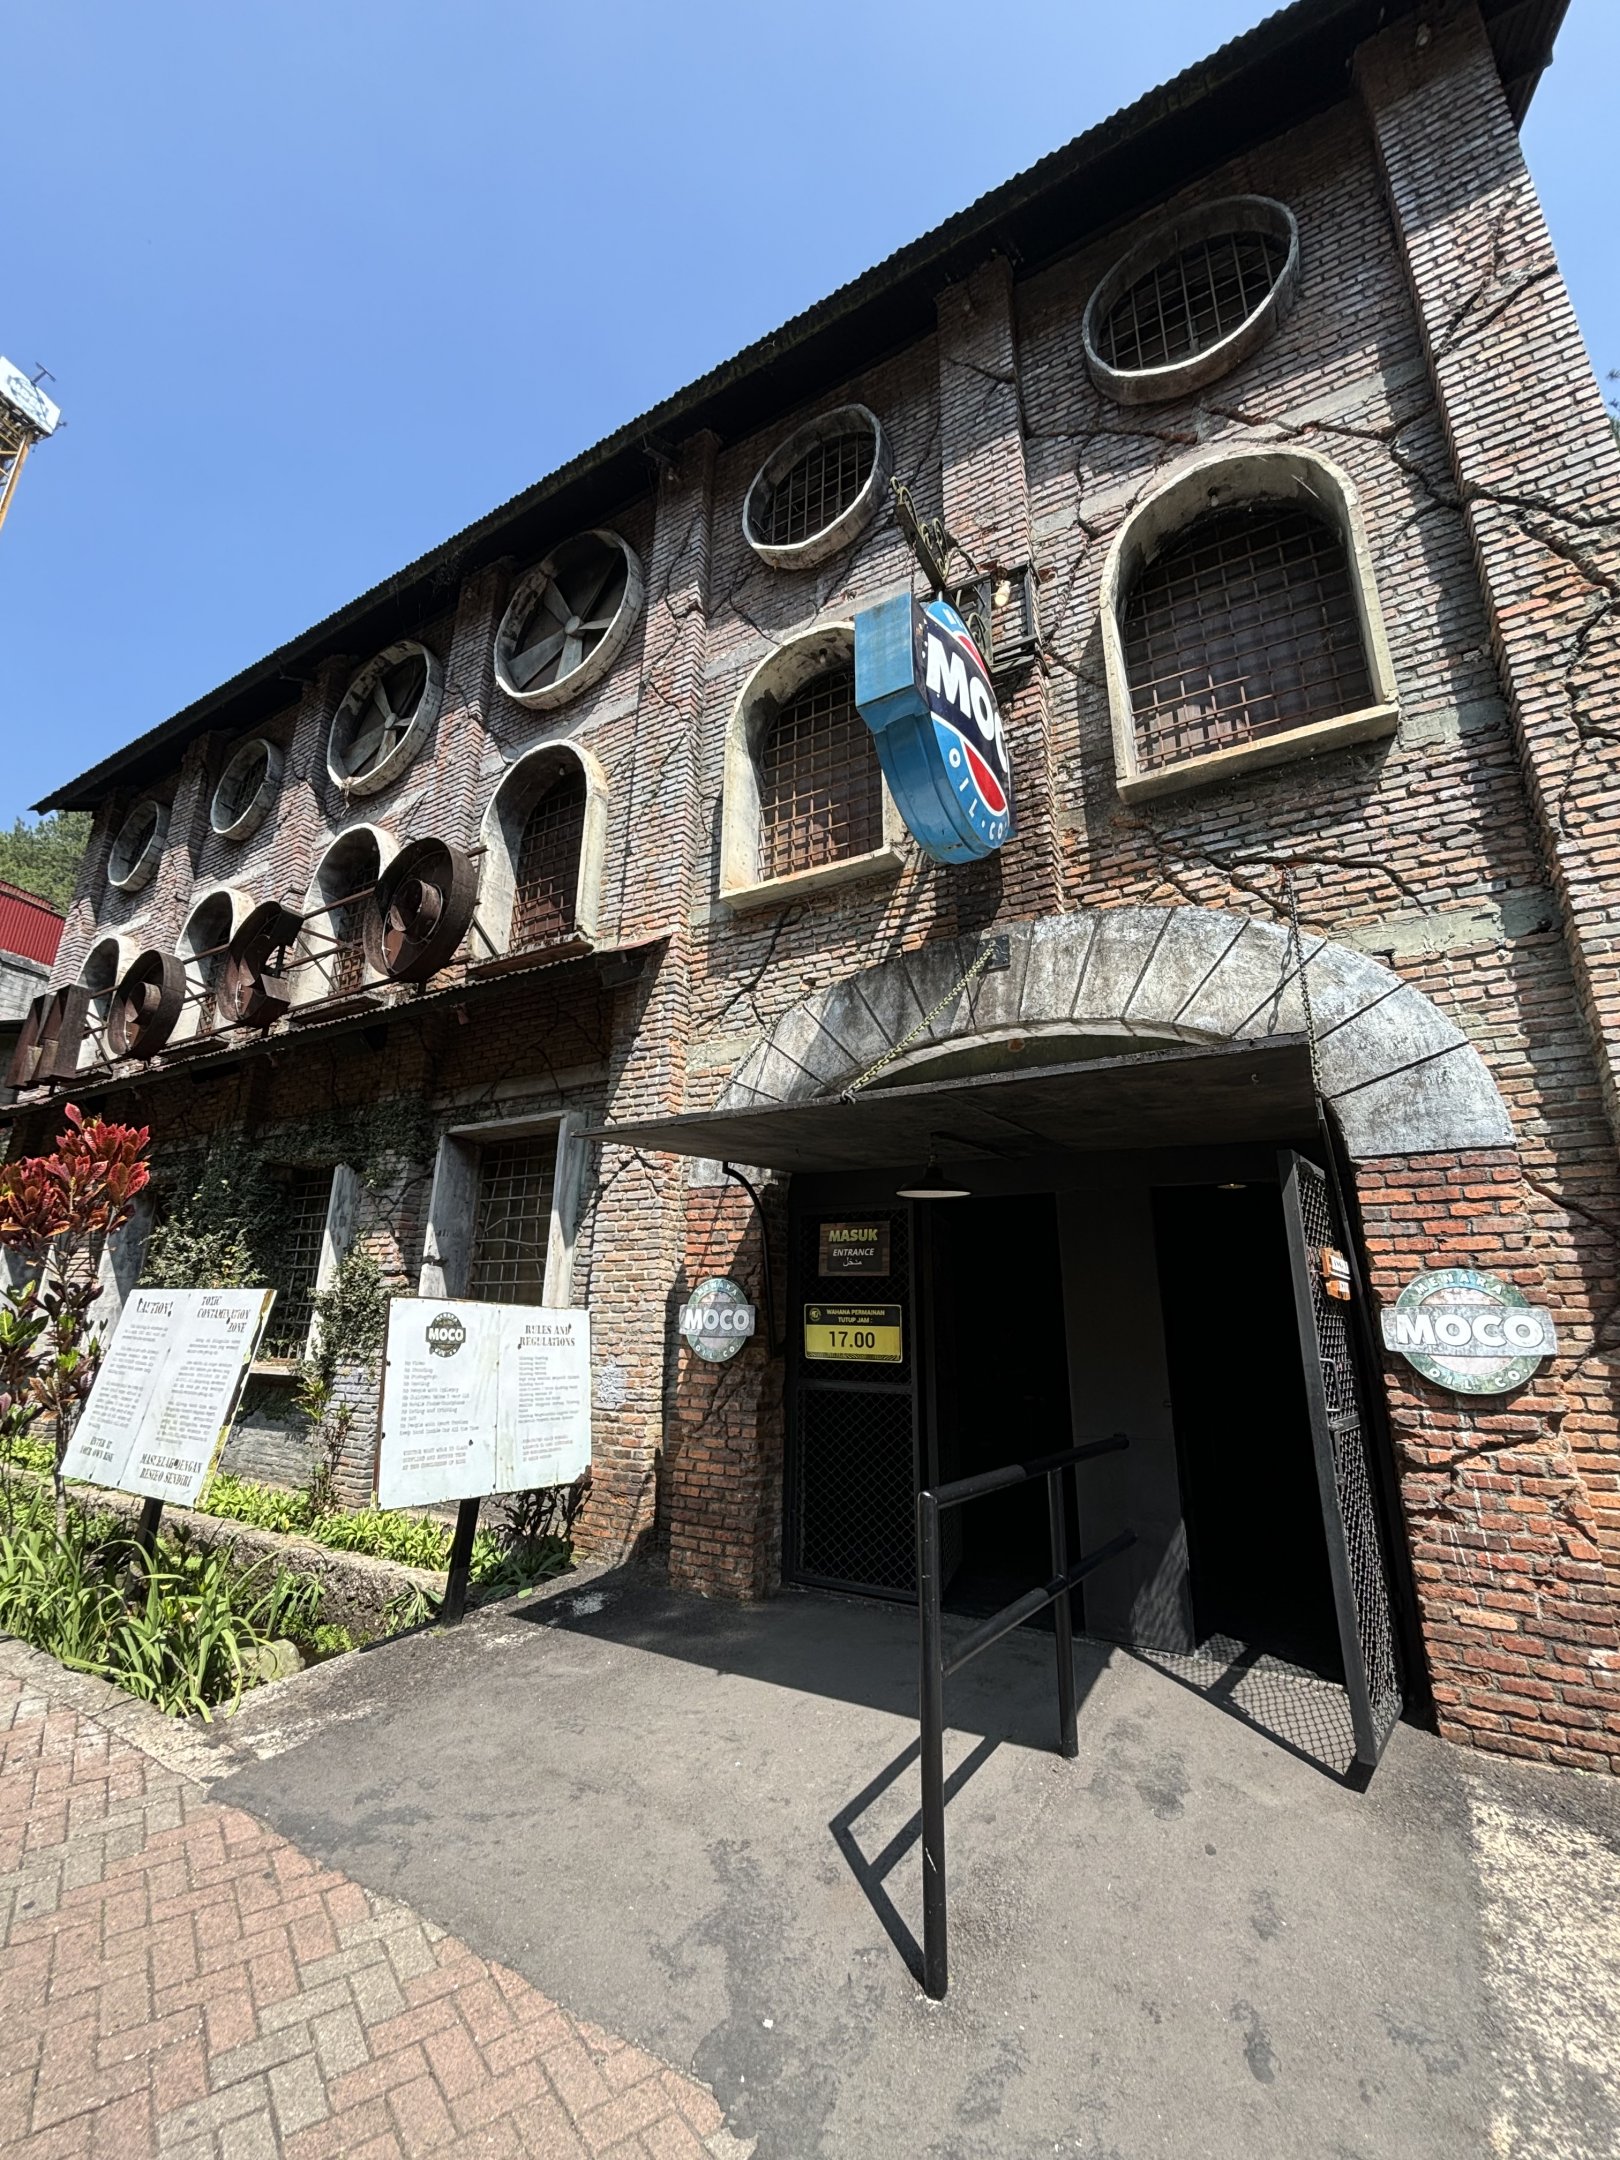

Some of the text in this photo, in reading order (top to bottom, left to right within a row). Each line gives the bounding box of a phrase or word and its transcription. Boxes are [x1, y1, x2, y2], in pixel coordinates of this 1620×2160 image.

[828, 1228, 878, 1242] MASUK
[832, 1247, 875, 1257] ENTRANCE
[1415, 1272, 1504, 1296] MENARA
[684, 1308, 750, 1331] MOCO
[826, 1308, 851, 1316] WAHANA
[428, 1327, 464, 1342] MOCO
[525, 1325, 572, 1336] RULES AND
[1395, 1313, 1545, 1348] MOCO
[519, 1336, 576, 1347] REGULATIONS
[829, 1330, 876, 1348] 17.00
[1429, 1367, 1472, 1390] OIL
